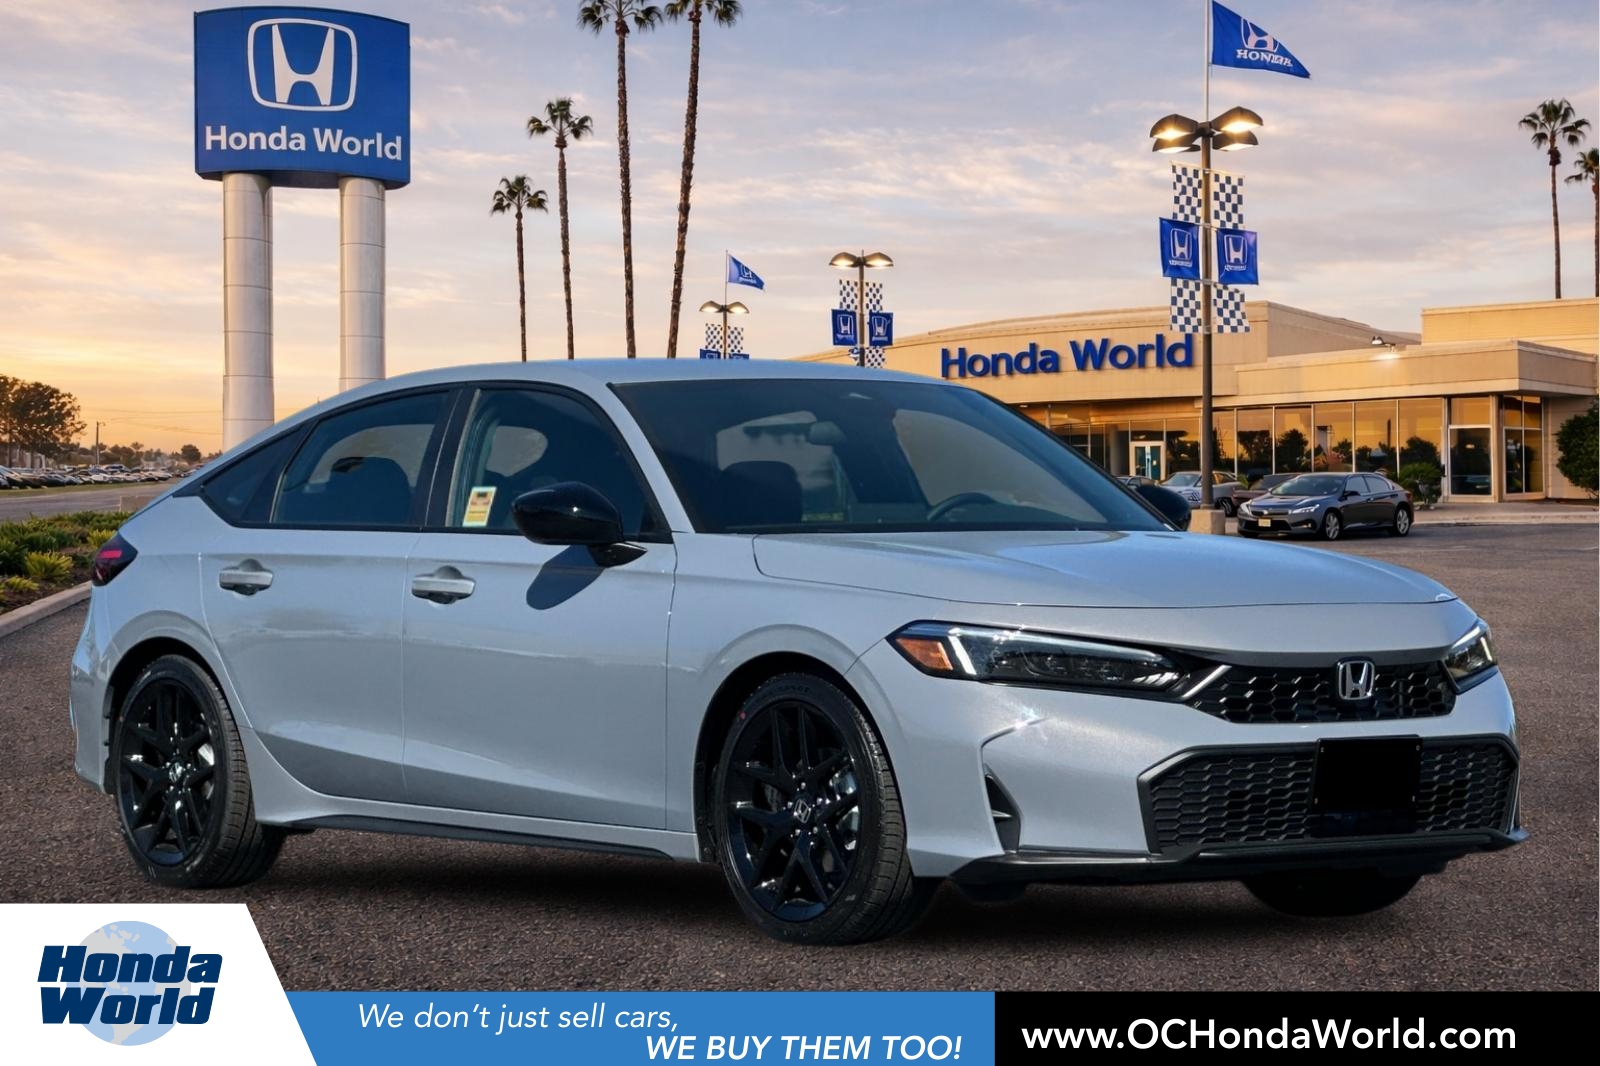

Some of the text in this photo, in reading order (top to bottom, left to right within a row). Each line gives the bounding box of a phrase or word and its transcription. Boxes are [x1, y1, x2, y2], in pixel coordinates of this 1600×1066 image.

[205, 125, 402, 162] Honda World
[941, 333, 1193, 378] Honda World
